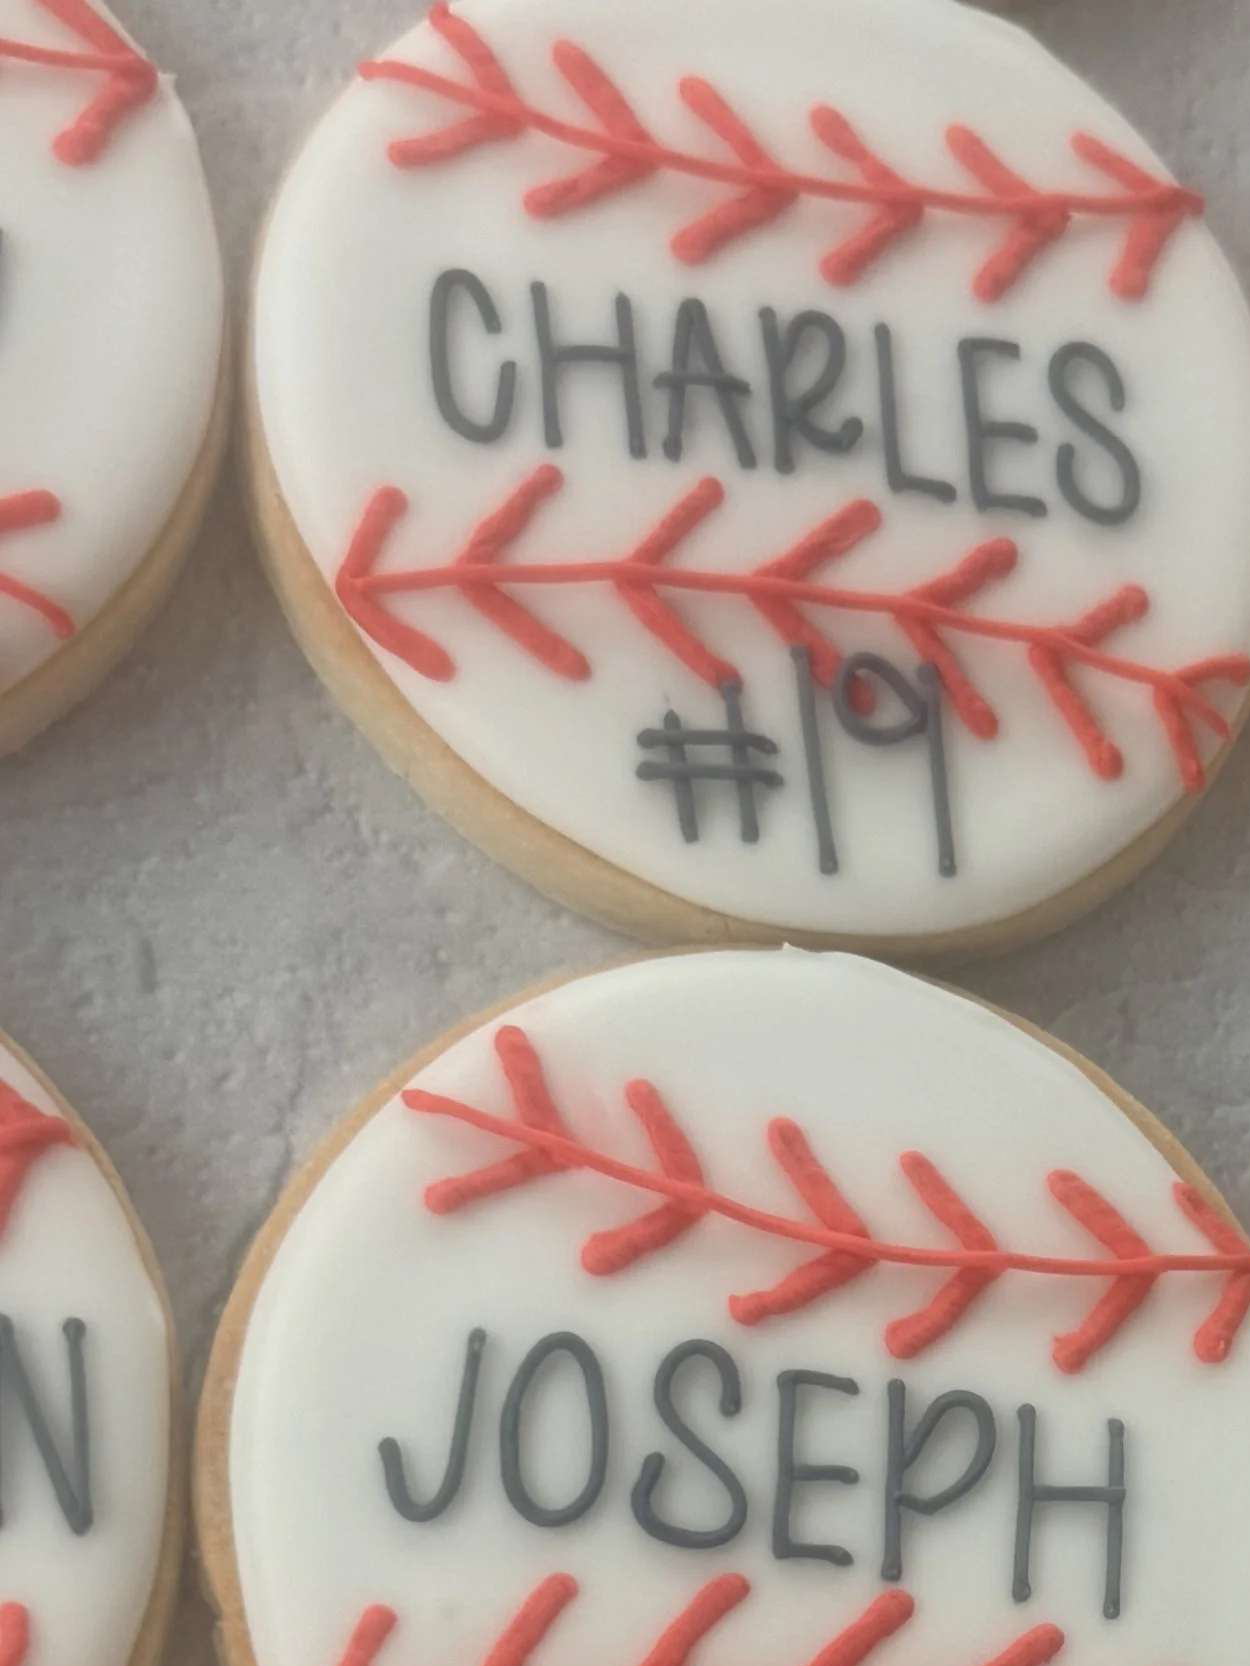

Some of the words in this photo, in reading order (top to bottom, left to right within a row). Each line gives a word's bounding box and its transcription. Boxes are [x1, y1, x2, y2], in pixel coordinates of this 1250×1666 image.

[429, 268, 1142, 527] CHARLES
[636, 647, 958, 876] #19
[379, 1328, 1130, 1620] JOSEPH
